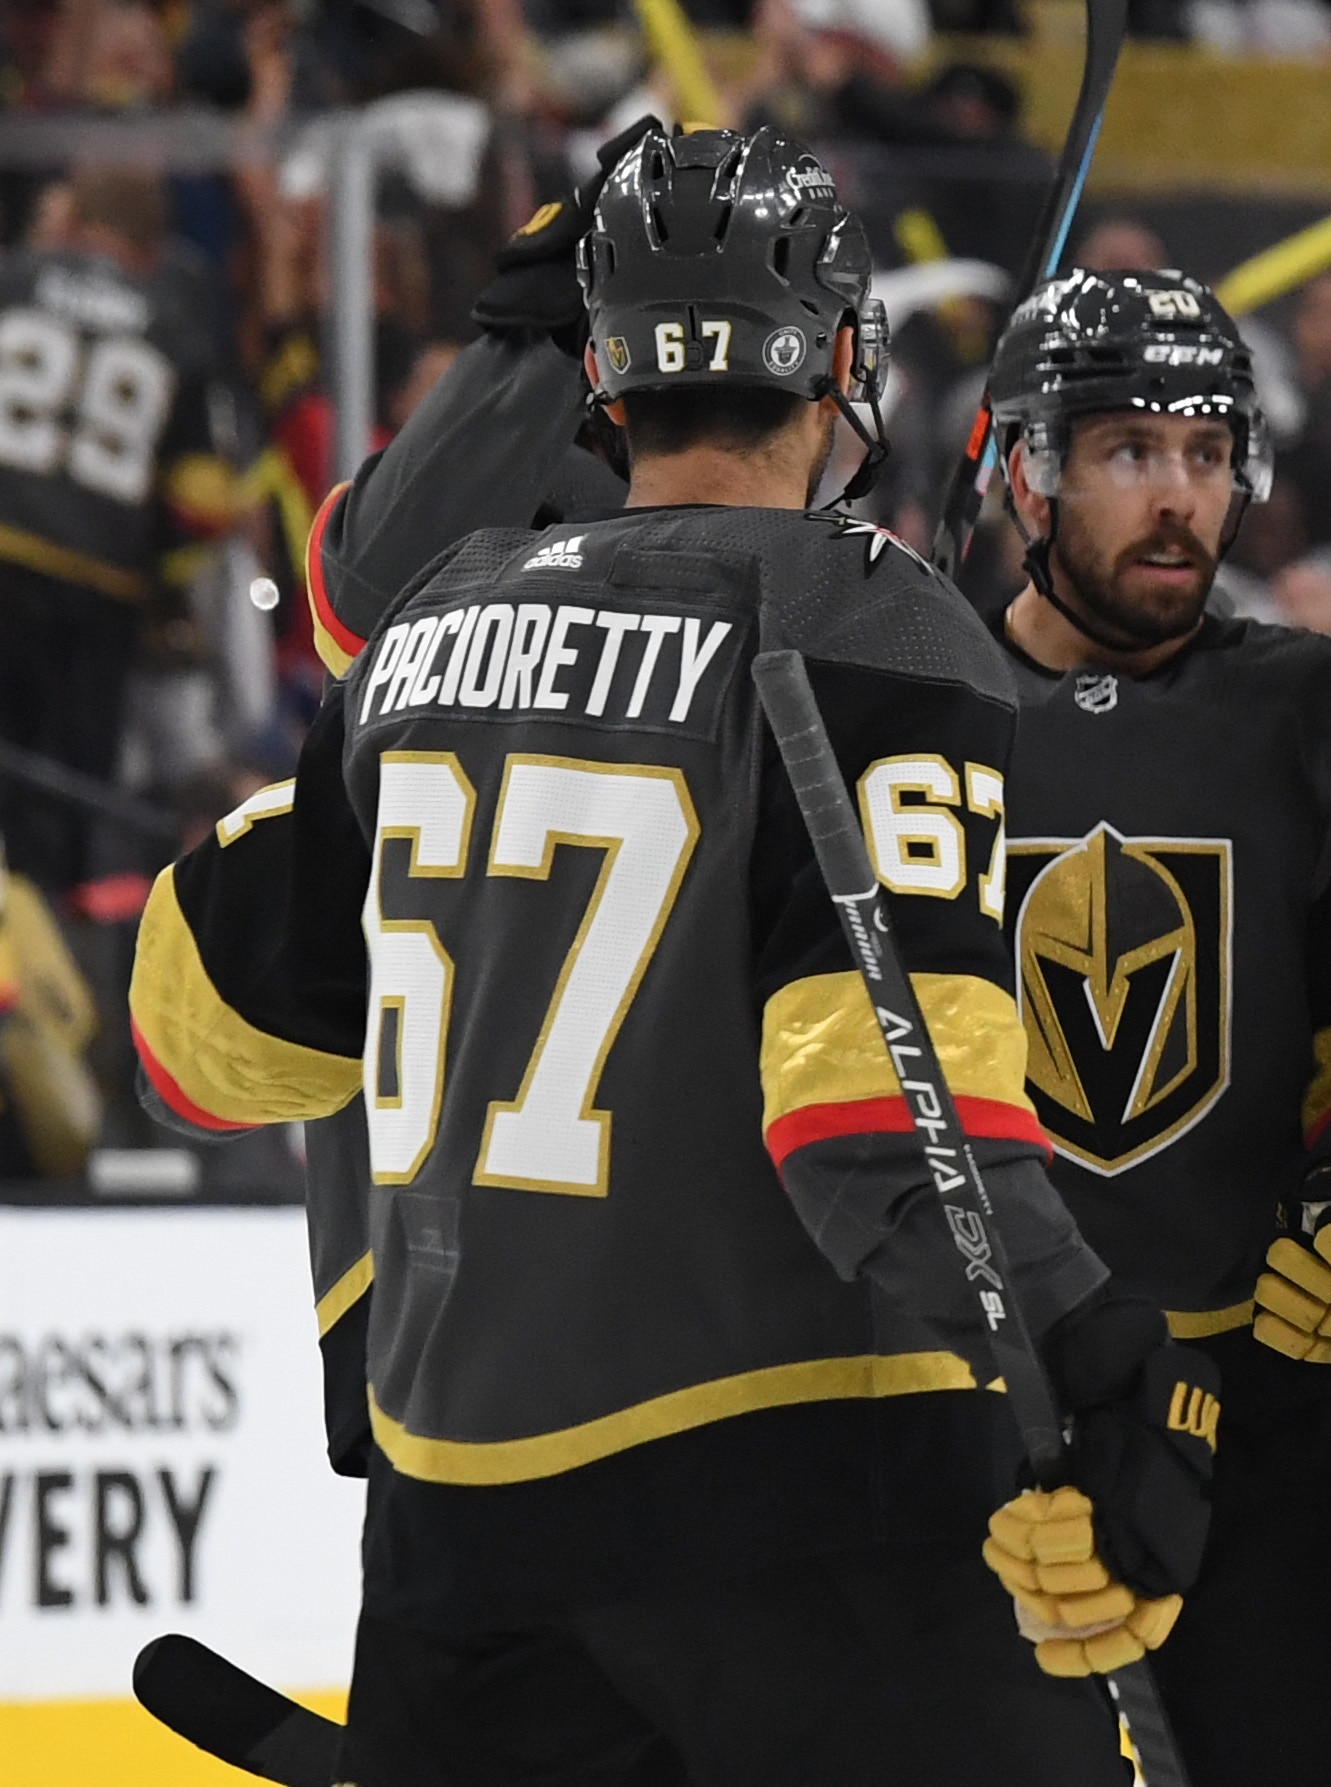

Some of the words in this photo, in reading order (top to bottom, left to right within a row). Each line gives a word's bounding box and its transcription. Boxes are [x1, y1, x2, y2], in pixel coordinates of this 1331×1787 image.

[655, 320, 732, 373] 67
[522, 552, 584, 569] adidas
[359, 603, 733, 726] PACIORETTY
[362, 750, 701, 1198] 67
[876, 1003, 967, 1194] ALPHA
[979, 1289, 1007, 1332] SL
